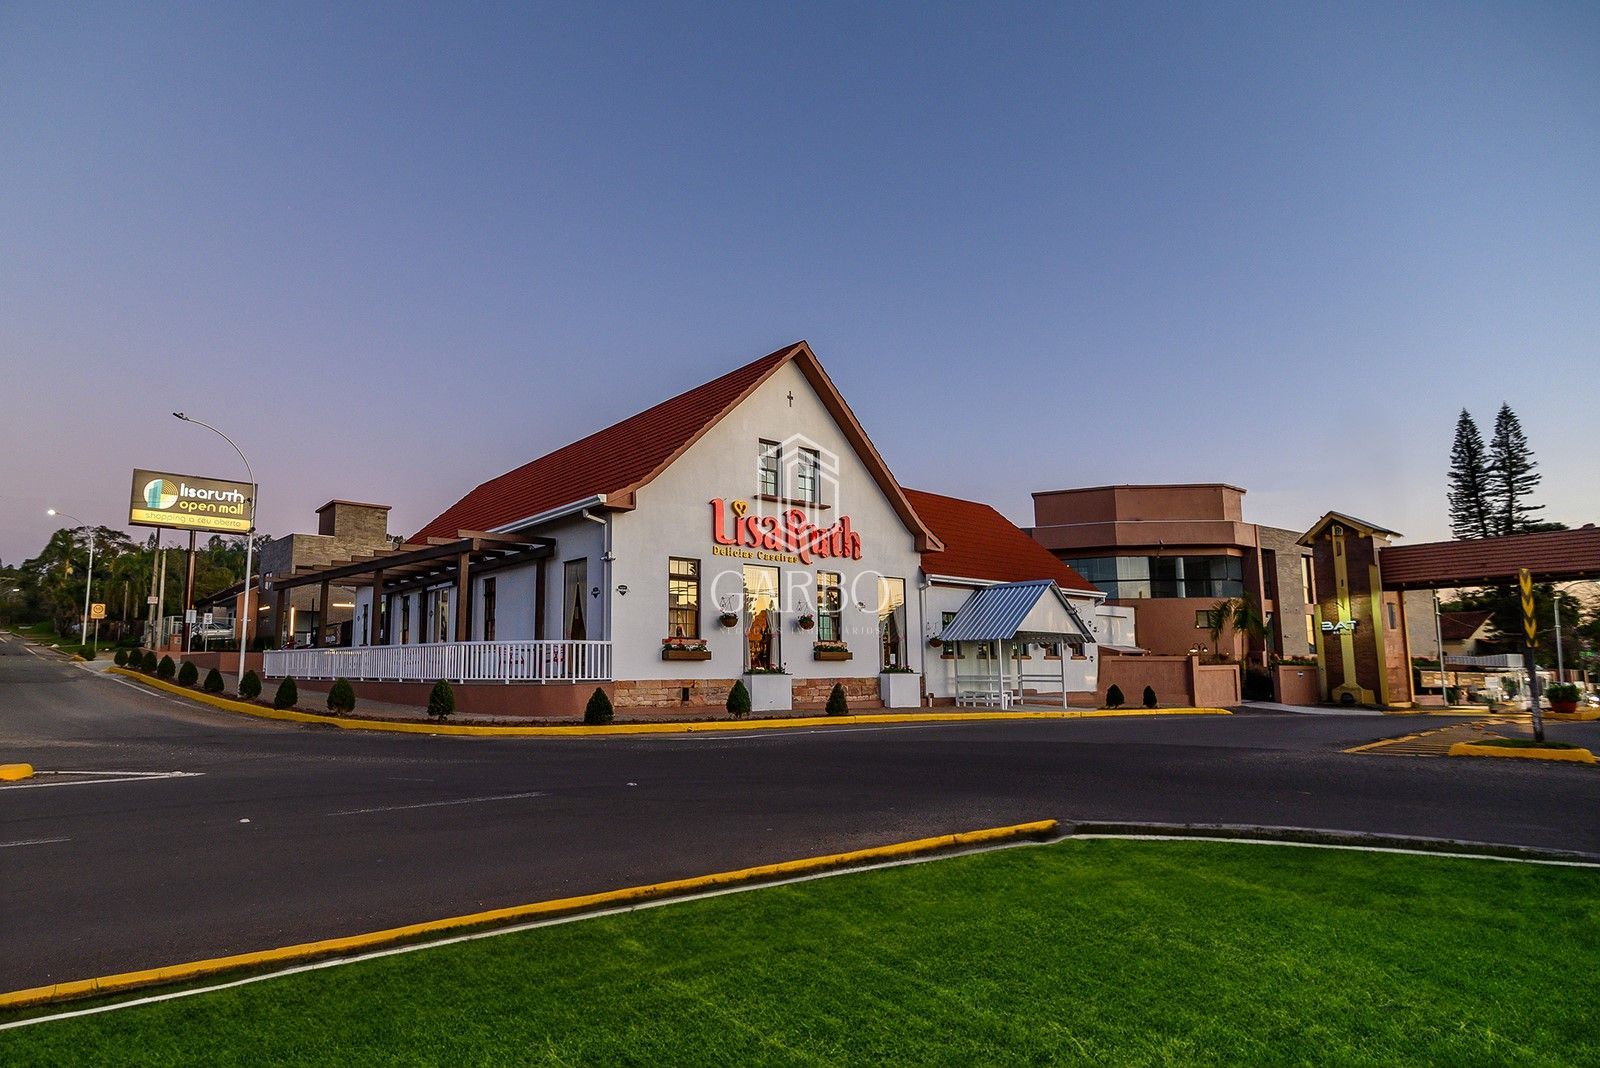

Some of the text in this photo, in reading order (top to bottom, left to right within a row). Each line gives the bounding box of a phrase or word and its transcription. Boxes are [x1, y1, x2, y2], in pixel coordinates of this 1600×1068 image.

[180, 483, 244, 503] lisaruth
[179, 501, 243, 515] open mall
[145, 512, 186, 523] shopping
[214, 518, 241, 527] aberto
[757, 551, 799, 563] Caseiras
[1321, 620, 1357, 630] BAT
